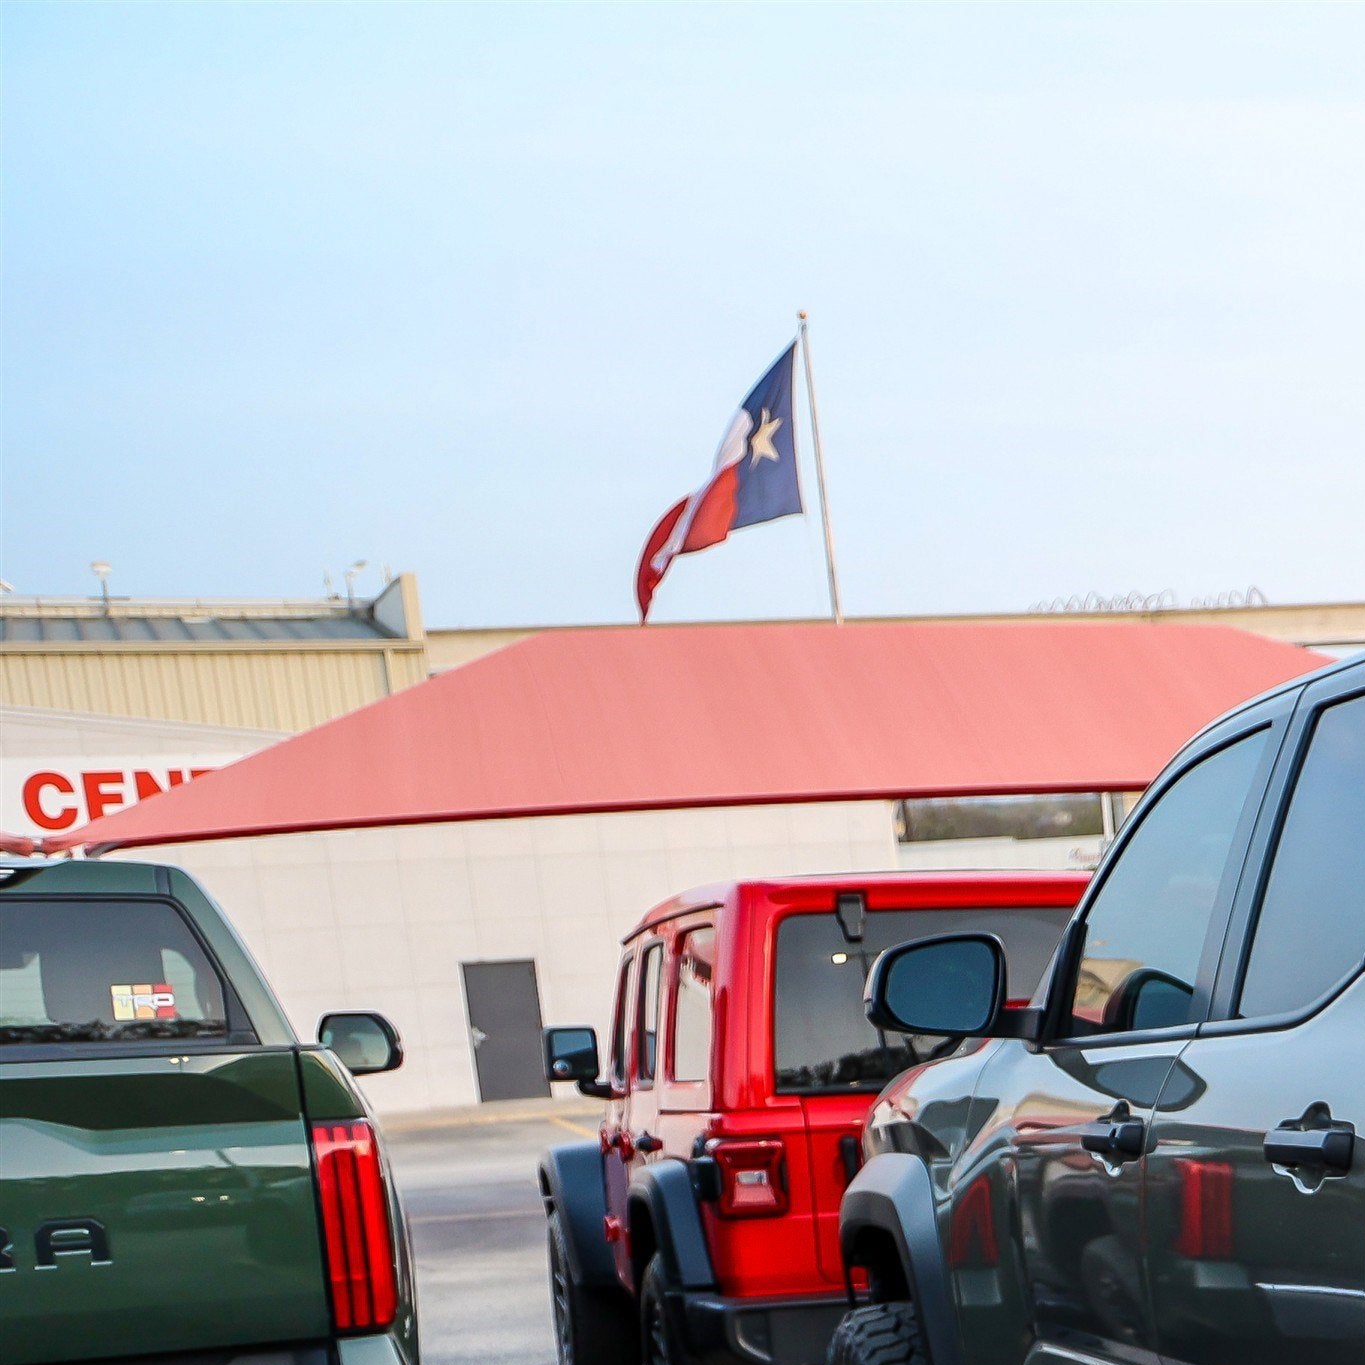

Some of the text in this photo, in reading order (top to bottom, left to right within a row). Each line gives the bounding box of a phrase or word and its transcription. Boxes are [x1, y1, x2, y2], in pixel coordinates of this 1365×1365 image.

[22, 769, 212, 830] CE
[113, 992, 175, 1011] TRD
[0, 1218, 113, 1274] A
